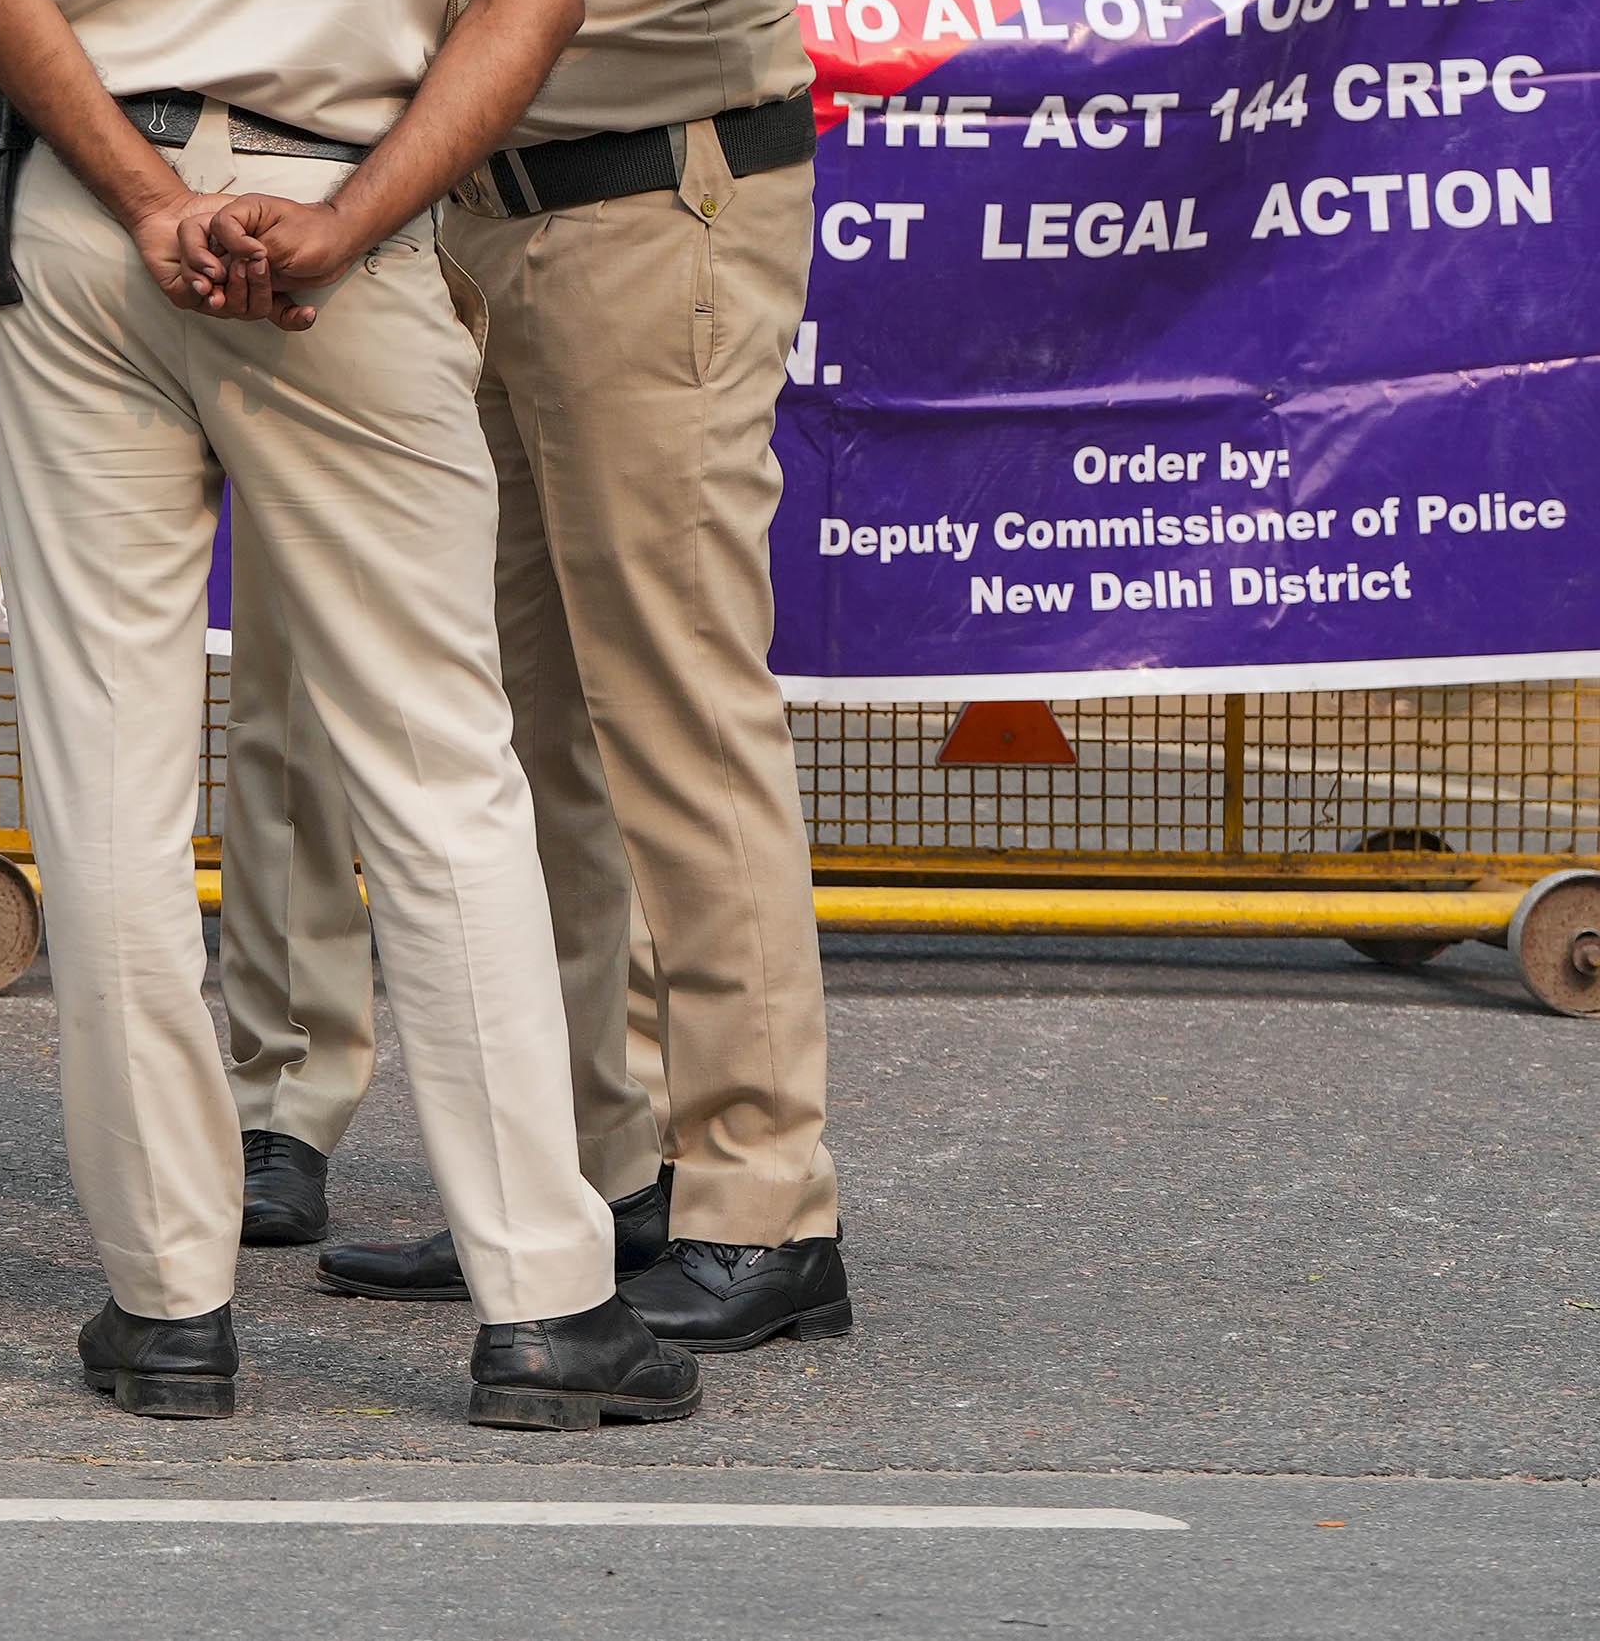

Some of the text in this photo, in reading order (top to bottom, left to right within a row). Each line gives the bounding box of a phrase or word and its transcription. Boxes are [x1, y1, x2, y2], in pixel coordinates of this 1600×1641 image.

[833, 55, 1546, 149] THE ACT 144 CRPC
[981, 197, 1208, 260] LEGAL
[1251, 166, 1553, 239] ACTION
[1073, 439, 1290, 492] Order by:
[819, 490, 1567, 564] Deputy Commissioner of Police
[971, 561, 1412, 614] New Delhi District
